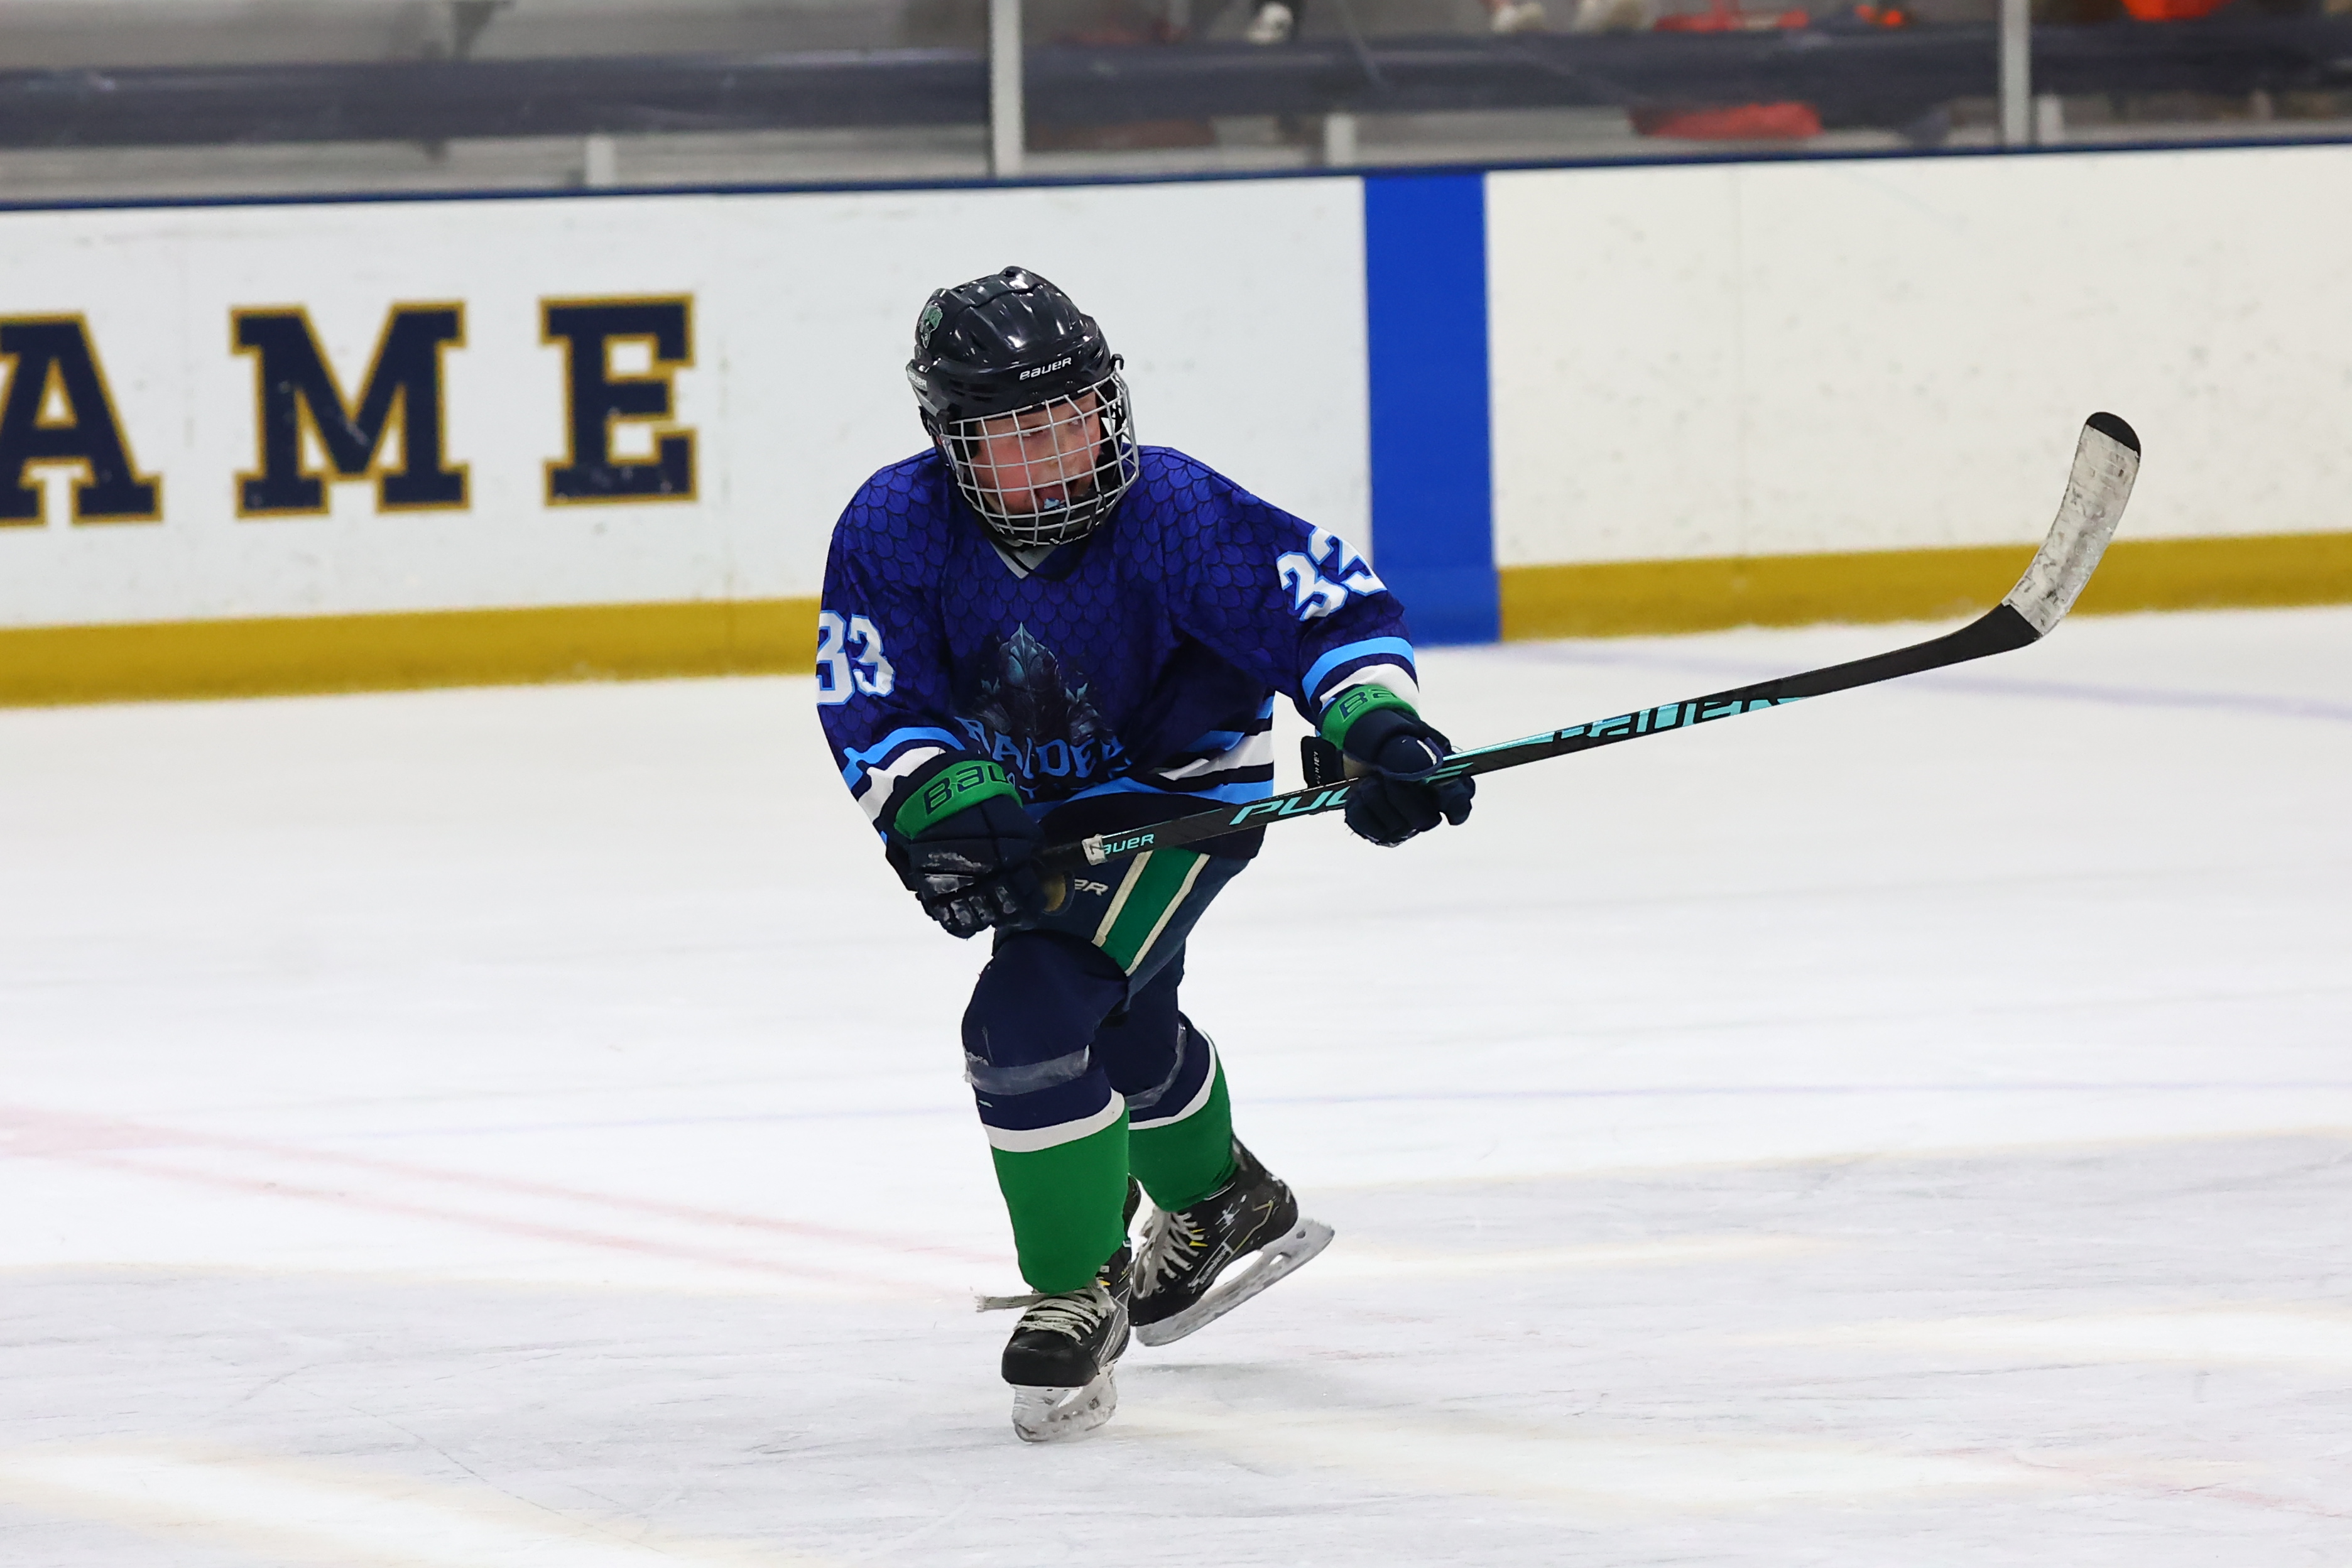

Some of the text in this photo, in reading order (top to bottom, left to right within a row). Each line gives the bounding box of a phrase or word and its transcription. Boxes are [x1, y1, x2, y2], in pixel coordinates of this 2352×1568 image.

[0, 294, 699, 526] AME
[1019, 357, 1072, 381] BAUER
[1276, 526, 1388, 621] 33
[816, 609, 896, 705] 33
[1103, 834, 1155, 855] AUER
